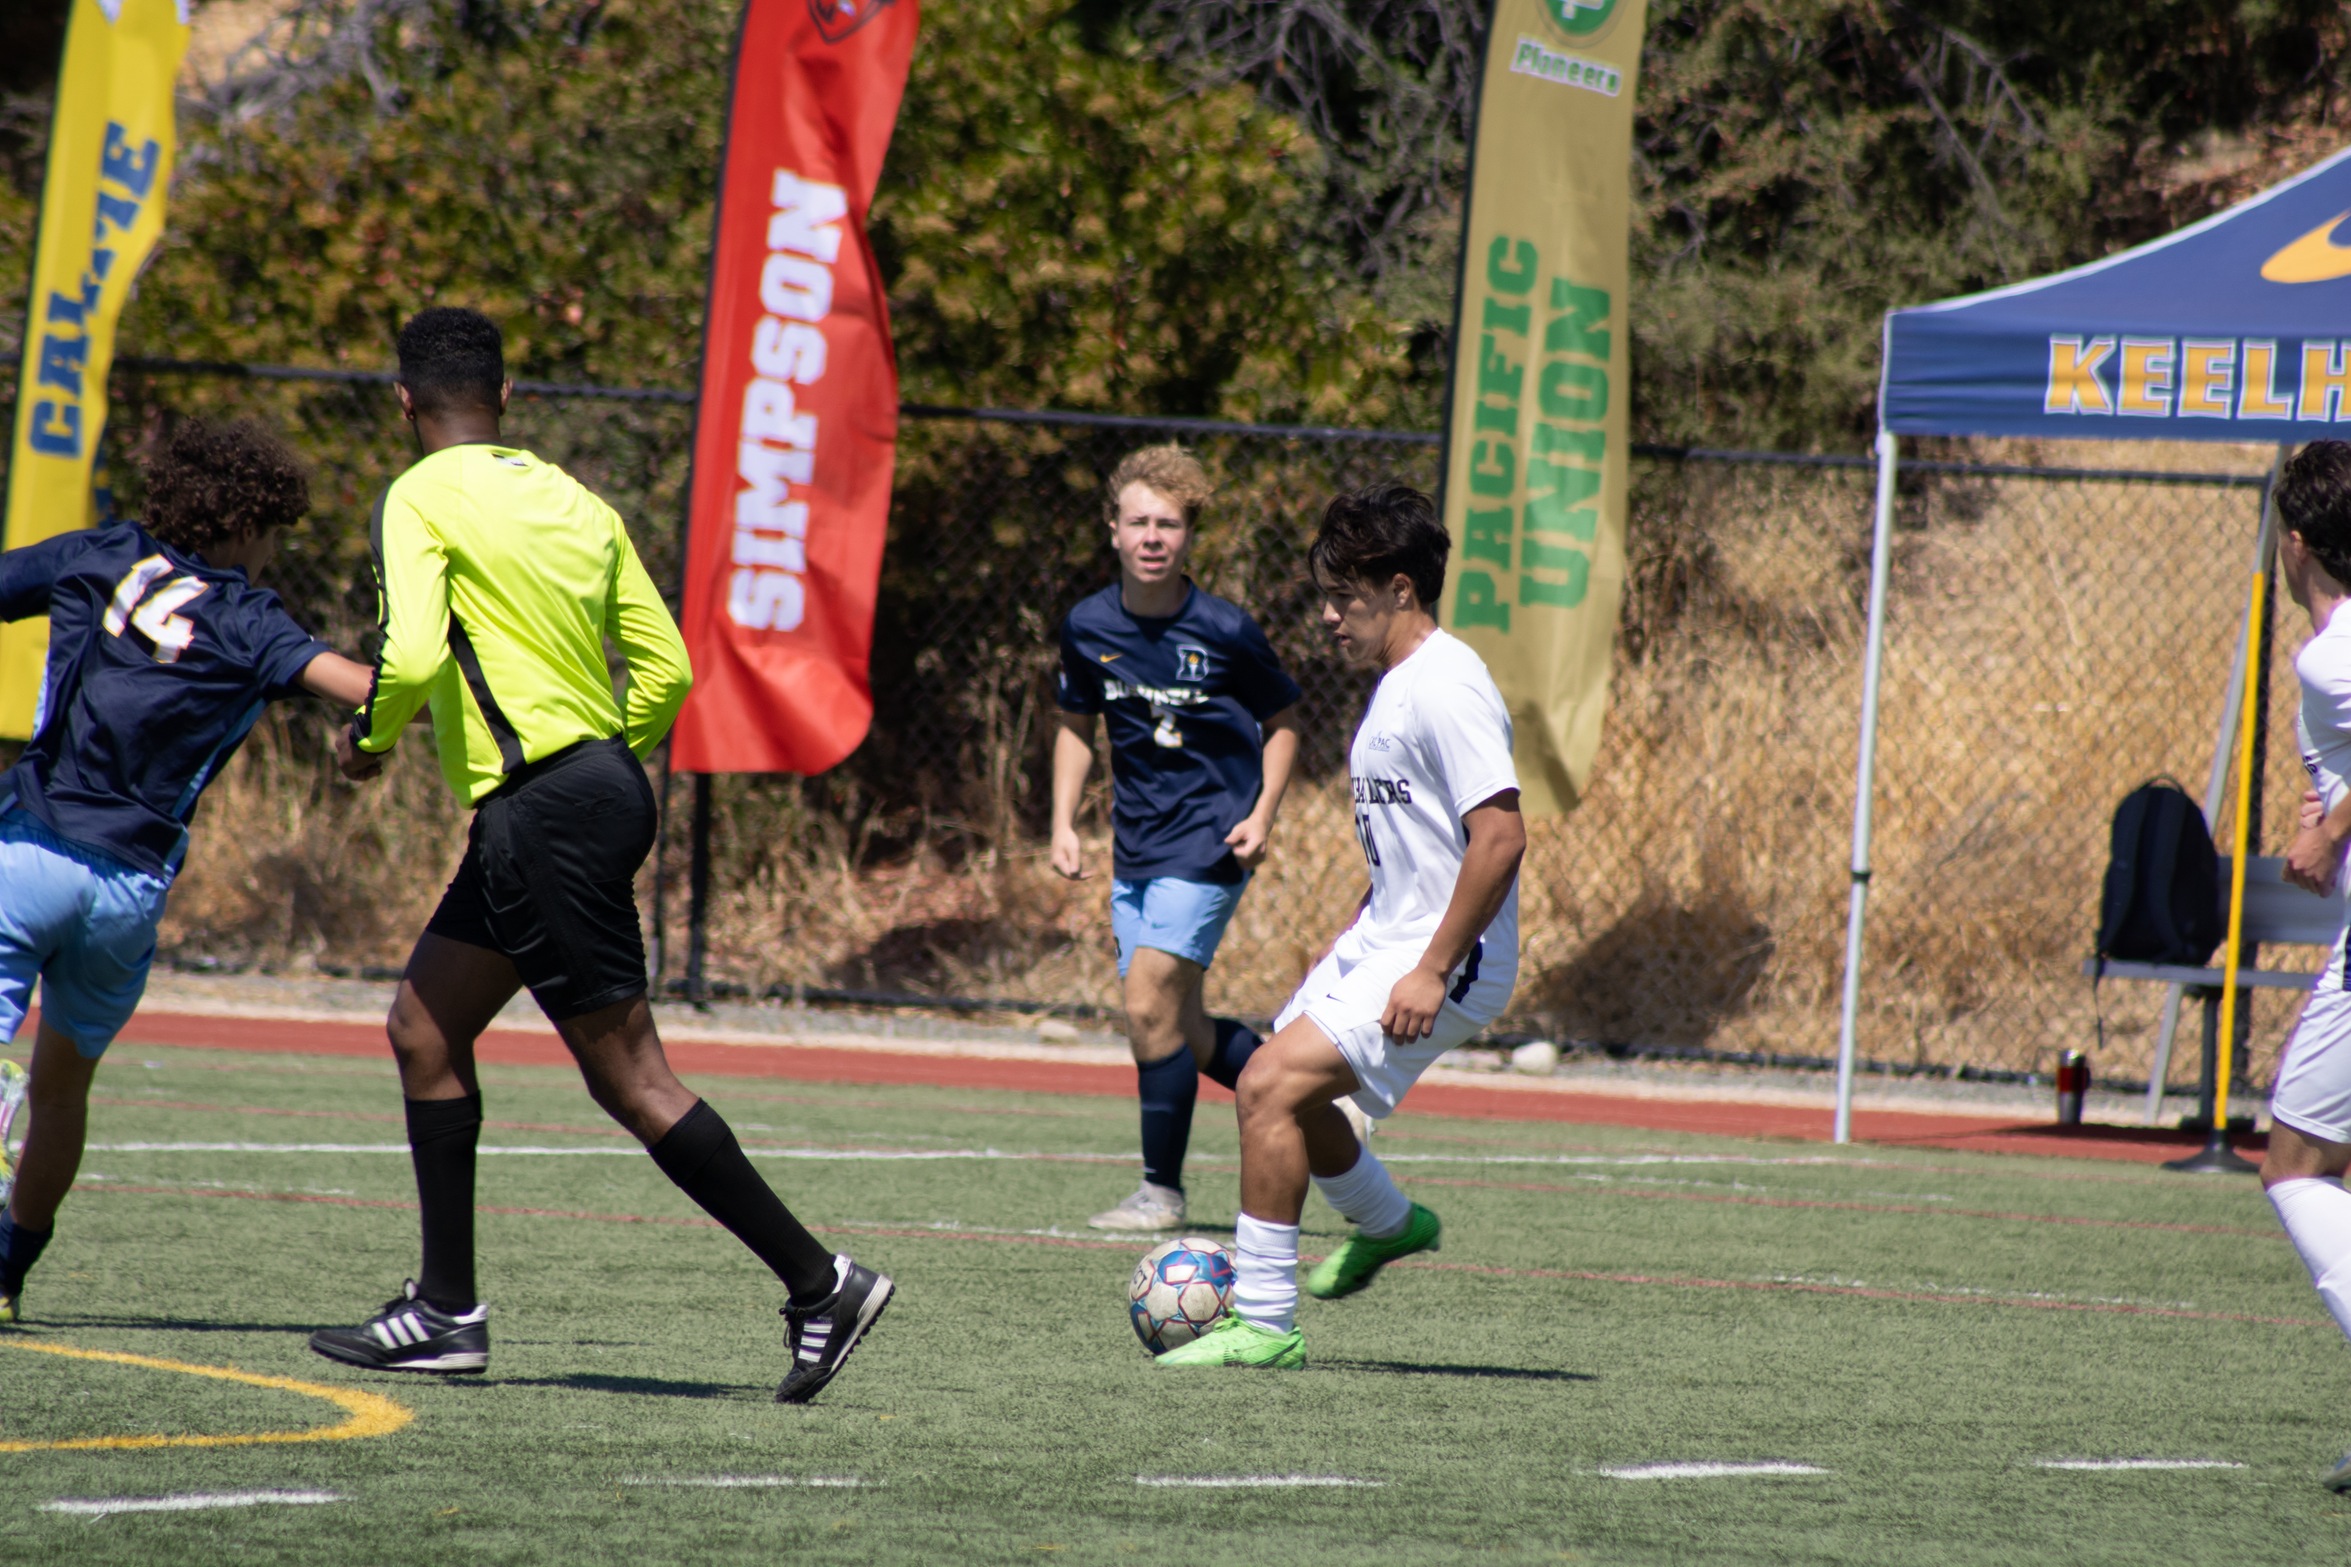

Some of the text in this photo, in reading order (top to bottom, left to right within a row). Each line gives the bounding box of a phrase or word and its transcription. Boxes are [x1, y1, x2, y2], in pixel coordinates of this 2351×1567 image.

[727, 168, 848, 632] SIMPSON
[1452, 235, 1539, 634] PACIFIC
[1518, 277, 1612, 609] UNION
[2044, 335, 2351, 421] KEELH
